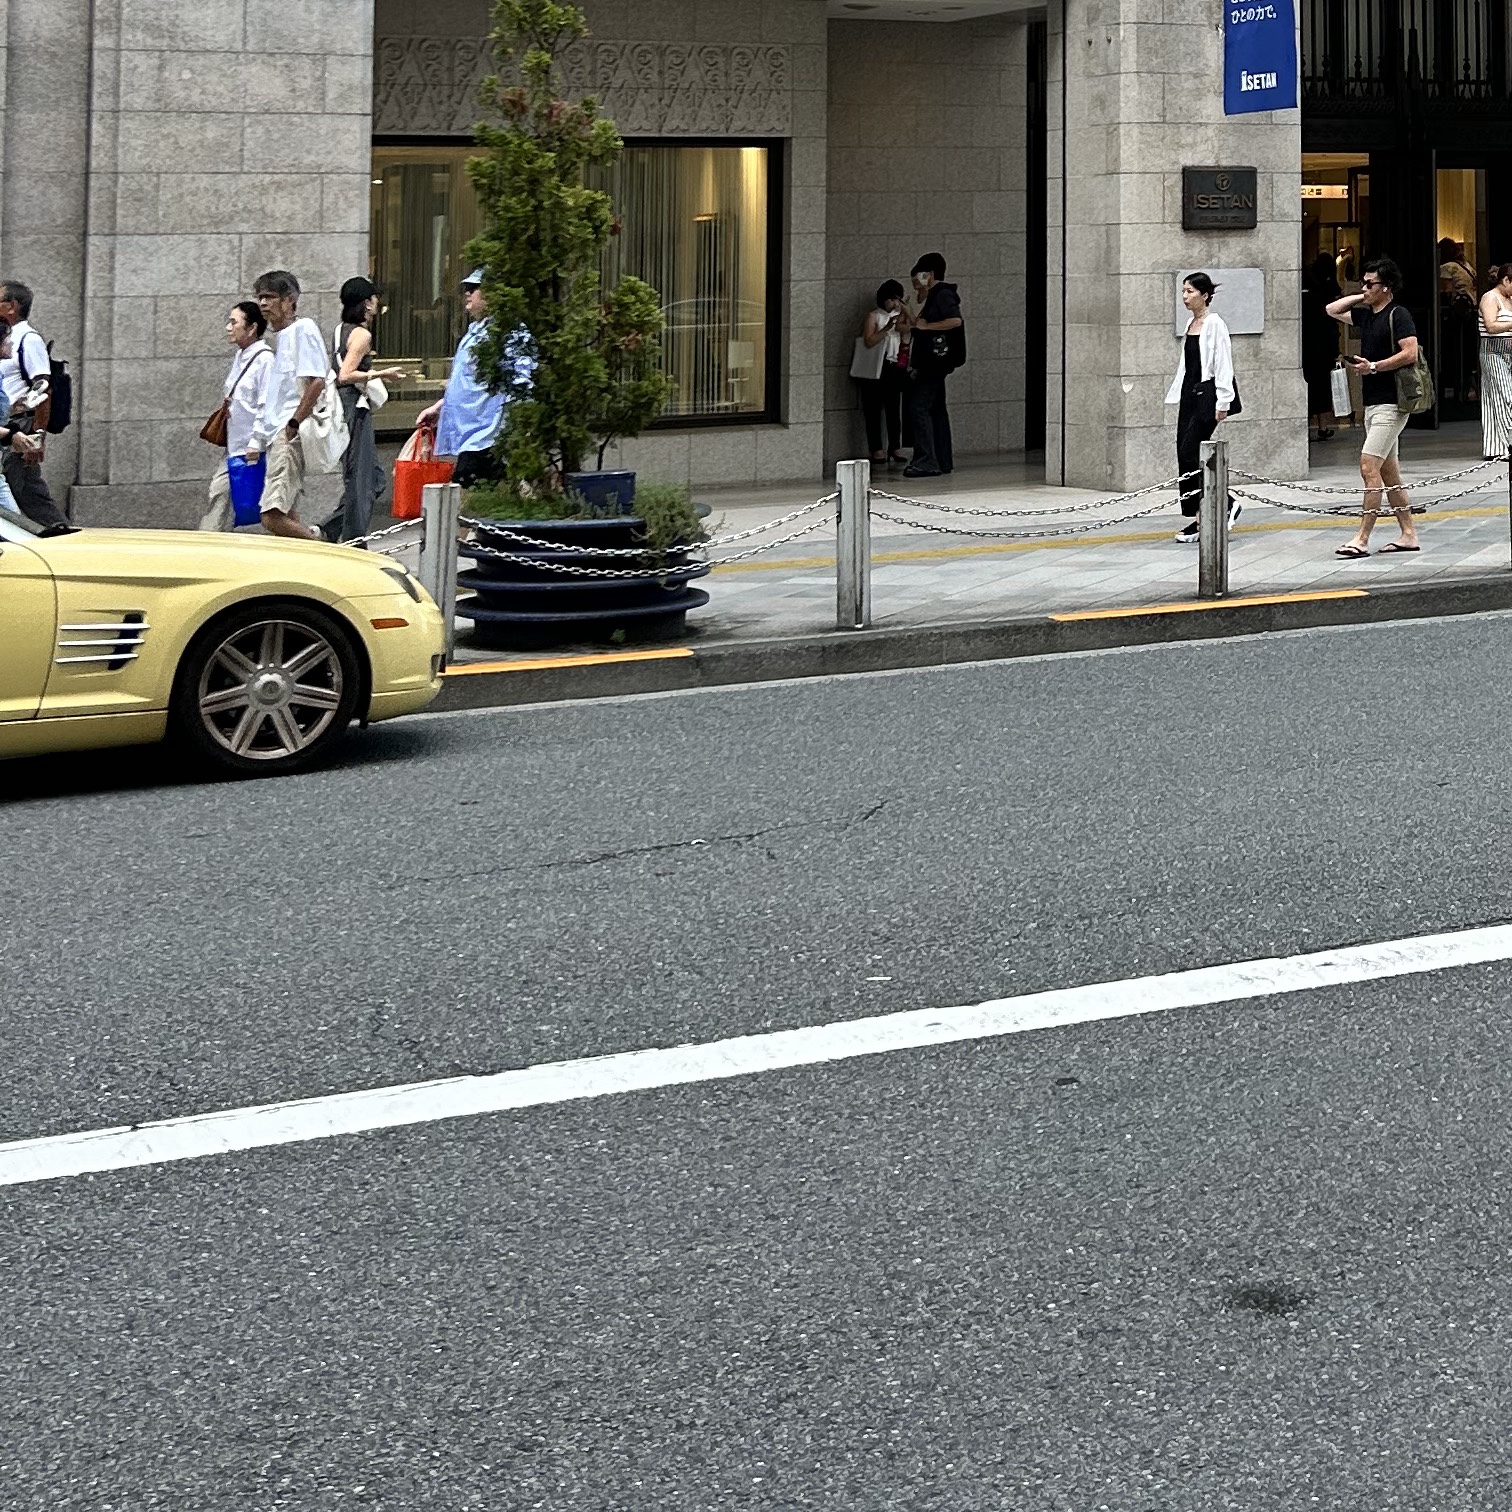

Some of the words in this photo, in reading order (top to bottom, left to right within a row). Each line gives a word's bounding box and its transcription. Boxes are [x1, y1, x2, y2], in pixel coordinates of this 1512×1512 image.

[1231, 5, 1277, 25] ひとの力で。
[1193, 194, 1253, 208] ISETAN
